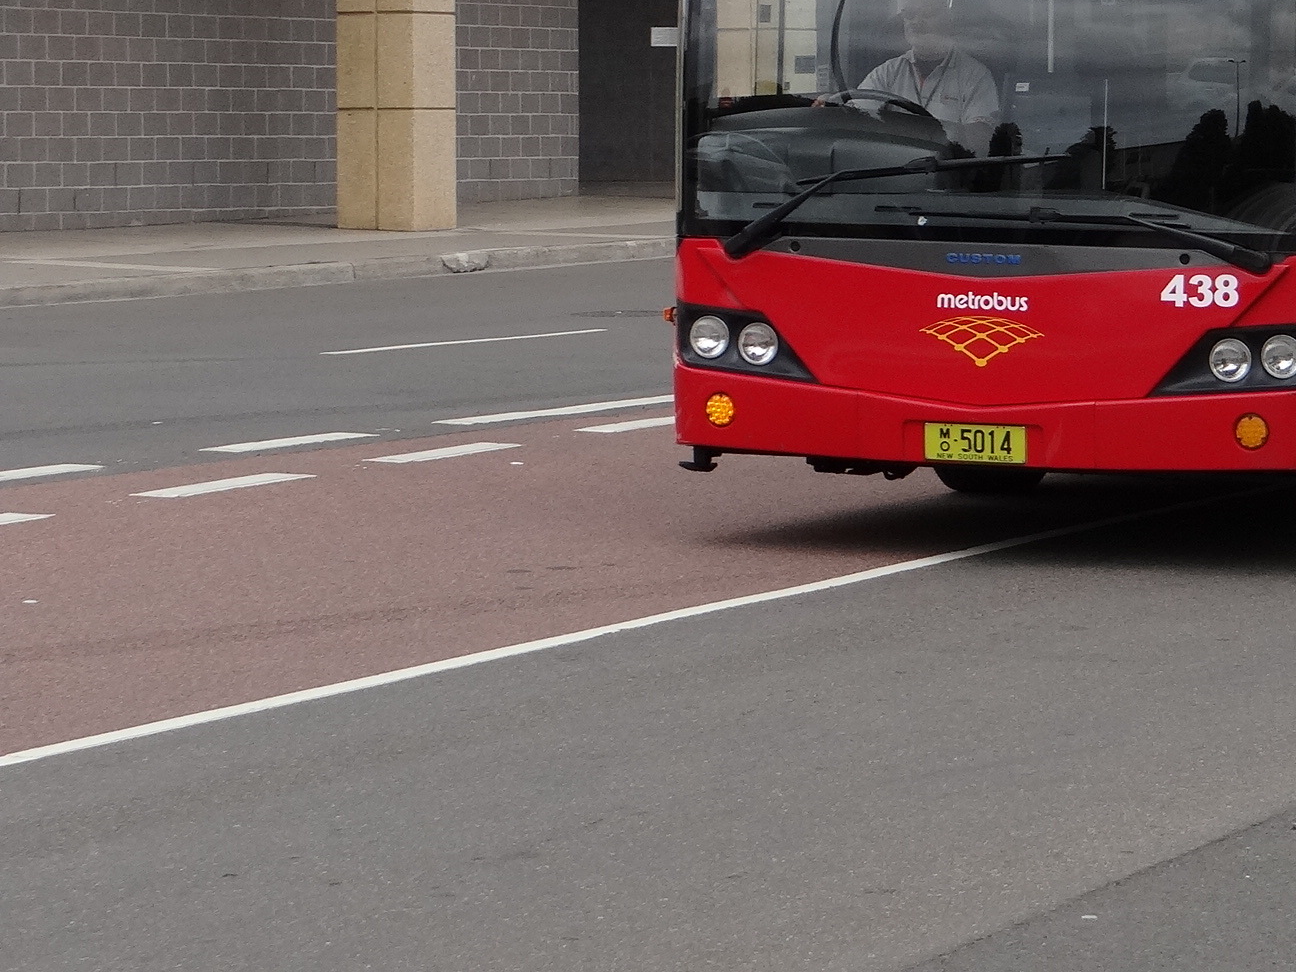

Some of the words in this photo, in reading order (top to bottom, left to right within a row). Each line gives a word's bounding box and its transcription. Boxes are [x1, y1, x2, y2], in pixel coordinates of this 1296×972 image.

[946, 252, 1022, 265] CUSTOM
[1160, 274, 1240, 308] 438
[937, 291, 1028, 311] metrobus
[958, 453, 983, 461] SOUTH
